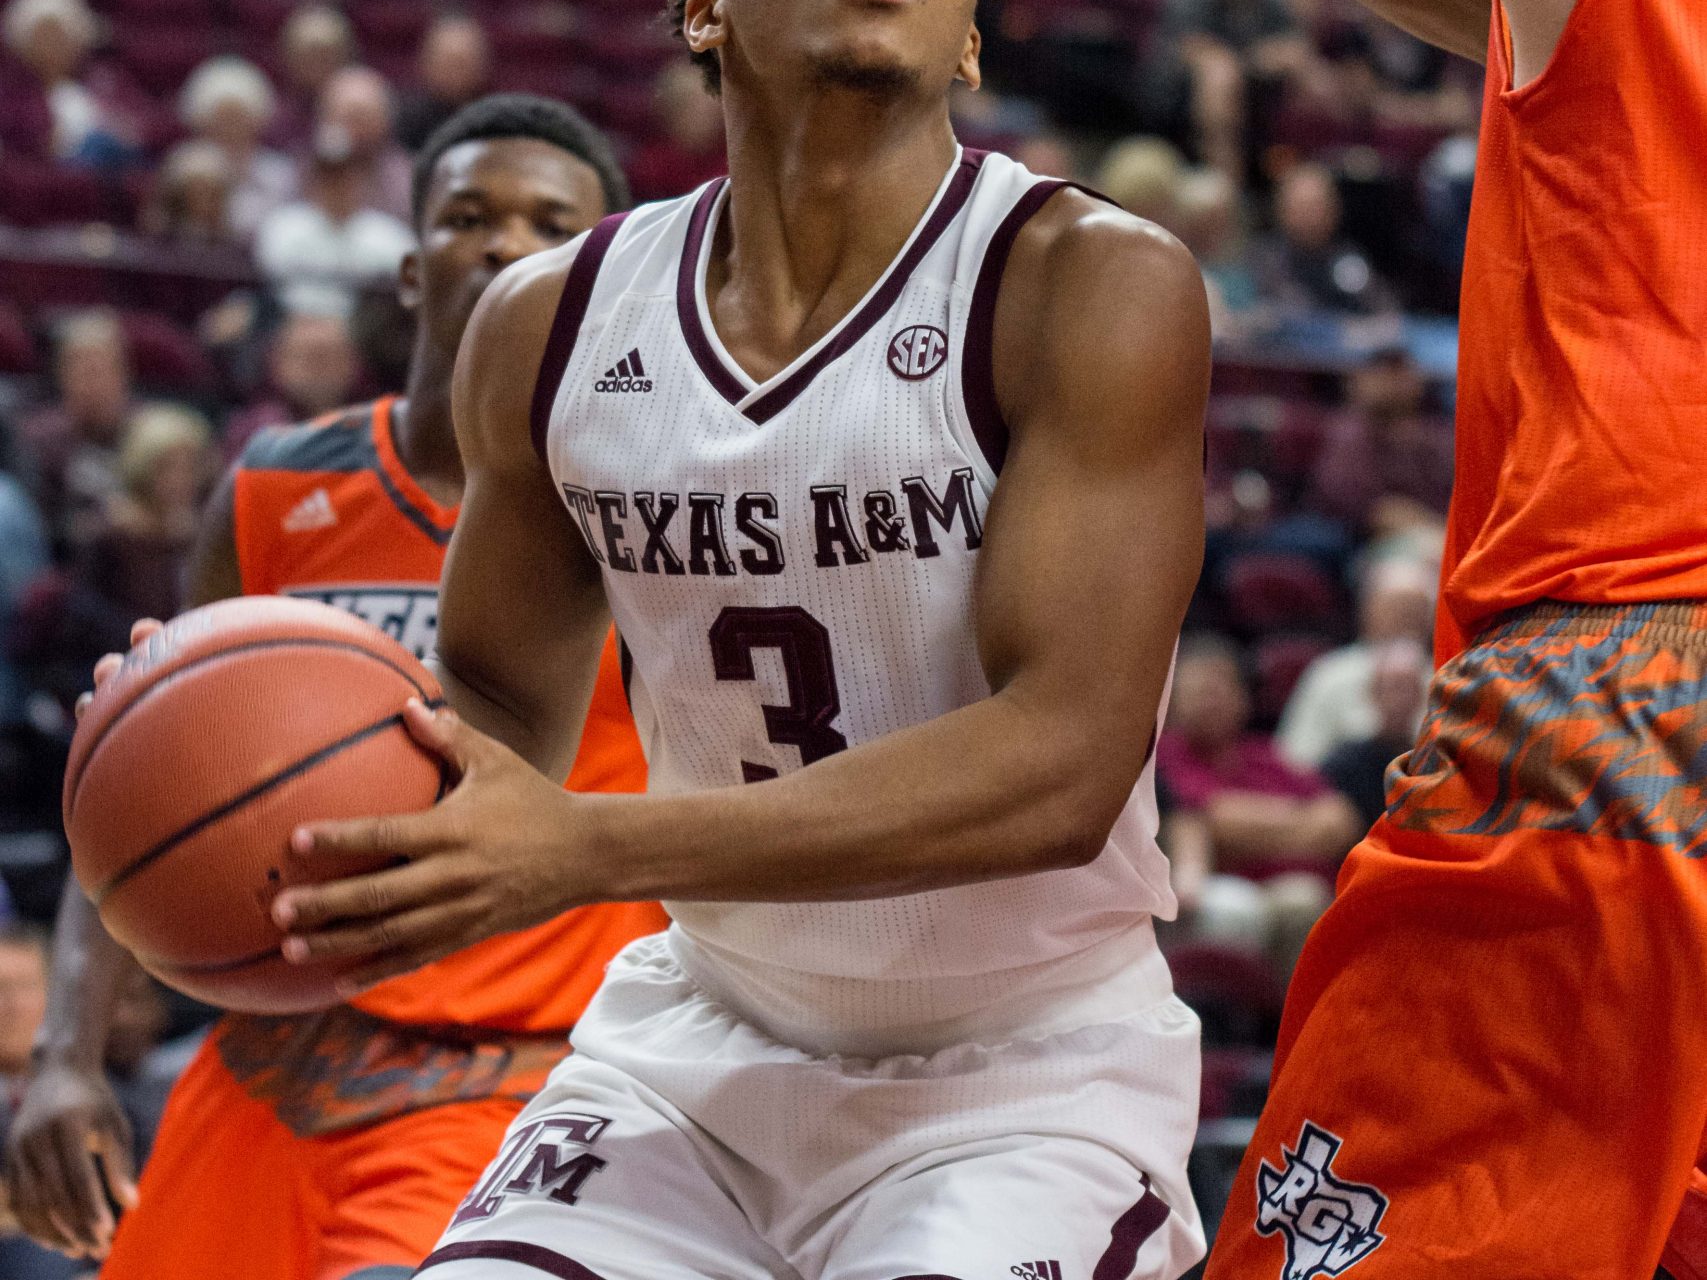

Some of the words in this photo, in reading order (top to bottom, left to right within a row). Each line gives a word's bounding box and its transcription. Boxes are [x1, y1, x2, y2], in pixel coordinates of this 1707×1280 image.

[595, 375, 653, 393] adidas
[890, 327, 946, 377] SEC
[562, 482, 786, 577] TEXAS
[809, 466, 984, 569] A&M
[708, 605, 848, 785] 3
